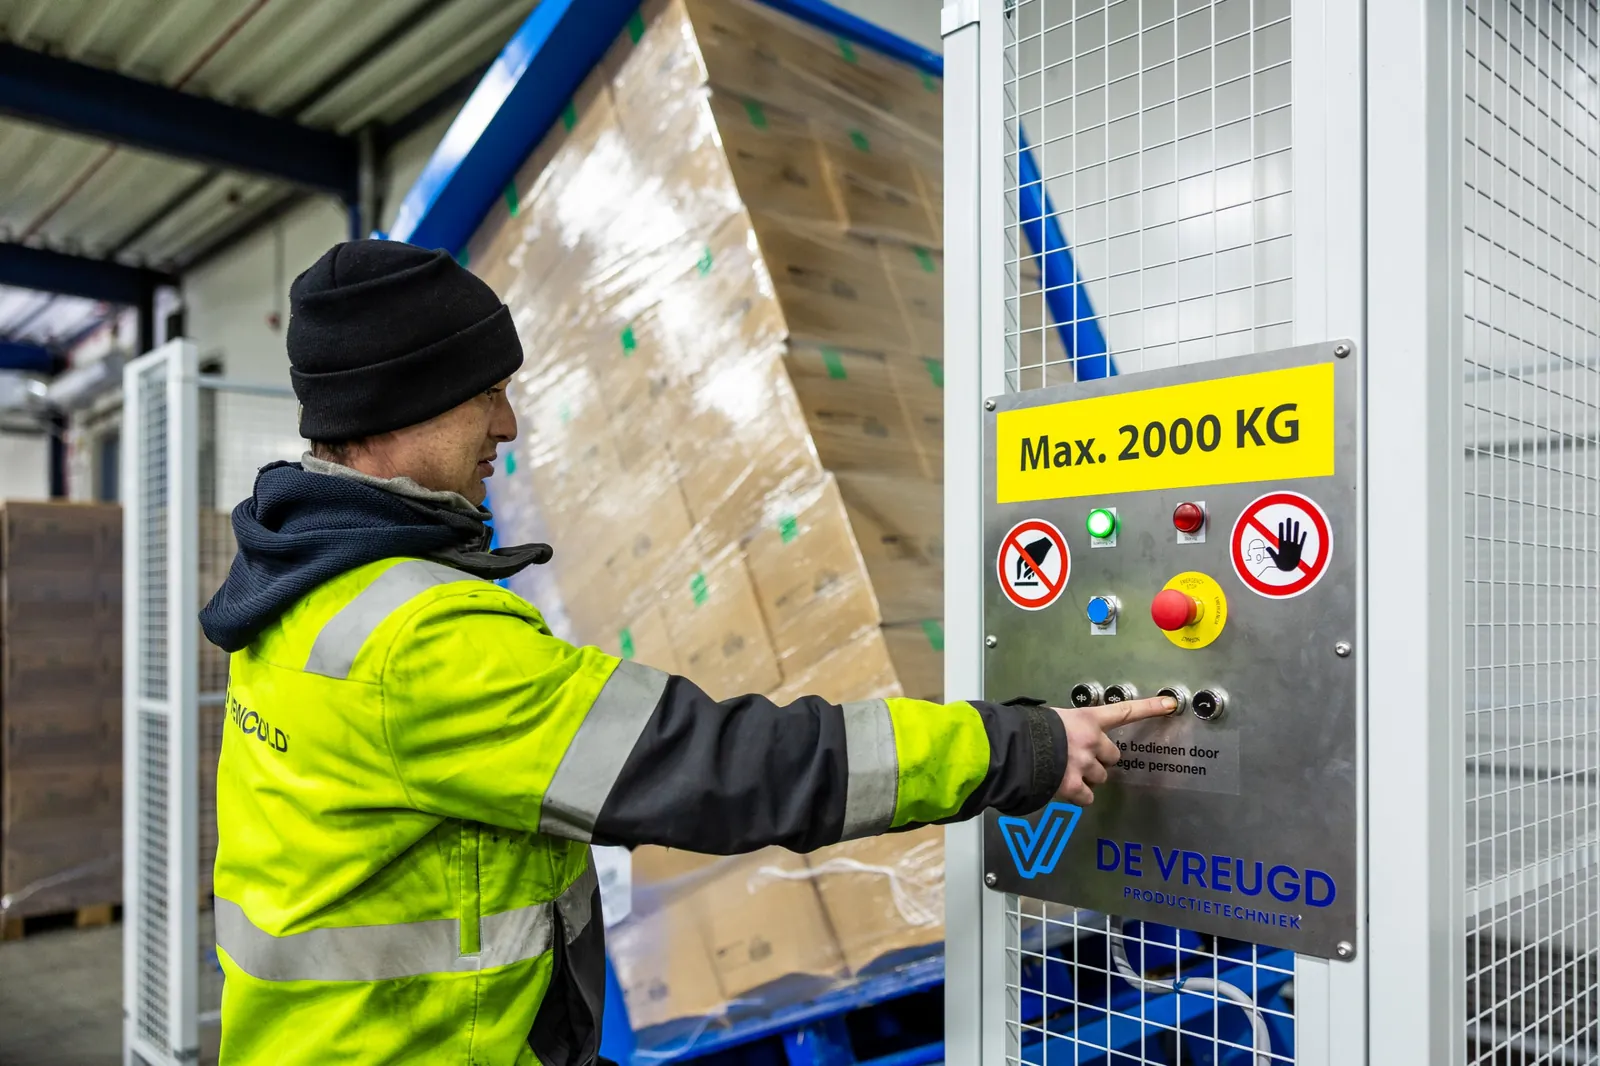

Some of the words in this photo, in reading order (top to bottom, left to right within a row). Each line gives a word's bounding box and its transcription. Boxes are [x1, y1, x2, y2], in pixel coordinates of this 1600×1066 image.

[1020, 435, 1106, 471] Max.
[1118, 414, 1221, 461] 2000
[1236, 403, 1299, 449] KG
[1131, 741, 1185, 756] bedienen
[1190, 746, 1219, 759] door
[1149, 761, 1206, 775] personen
[1097, 839, 1143, 877] DE
[1152, 846, 1336, 907] VREUGD
[1124, 887, 1302, 930] PRODUCTIETECHNIEK
